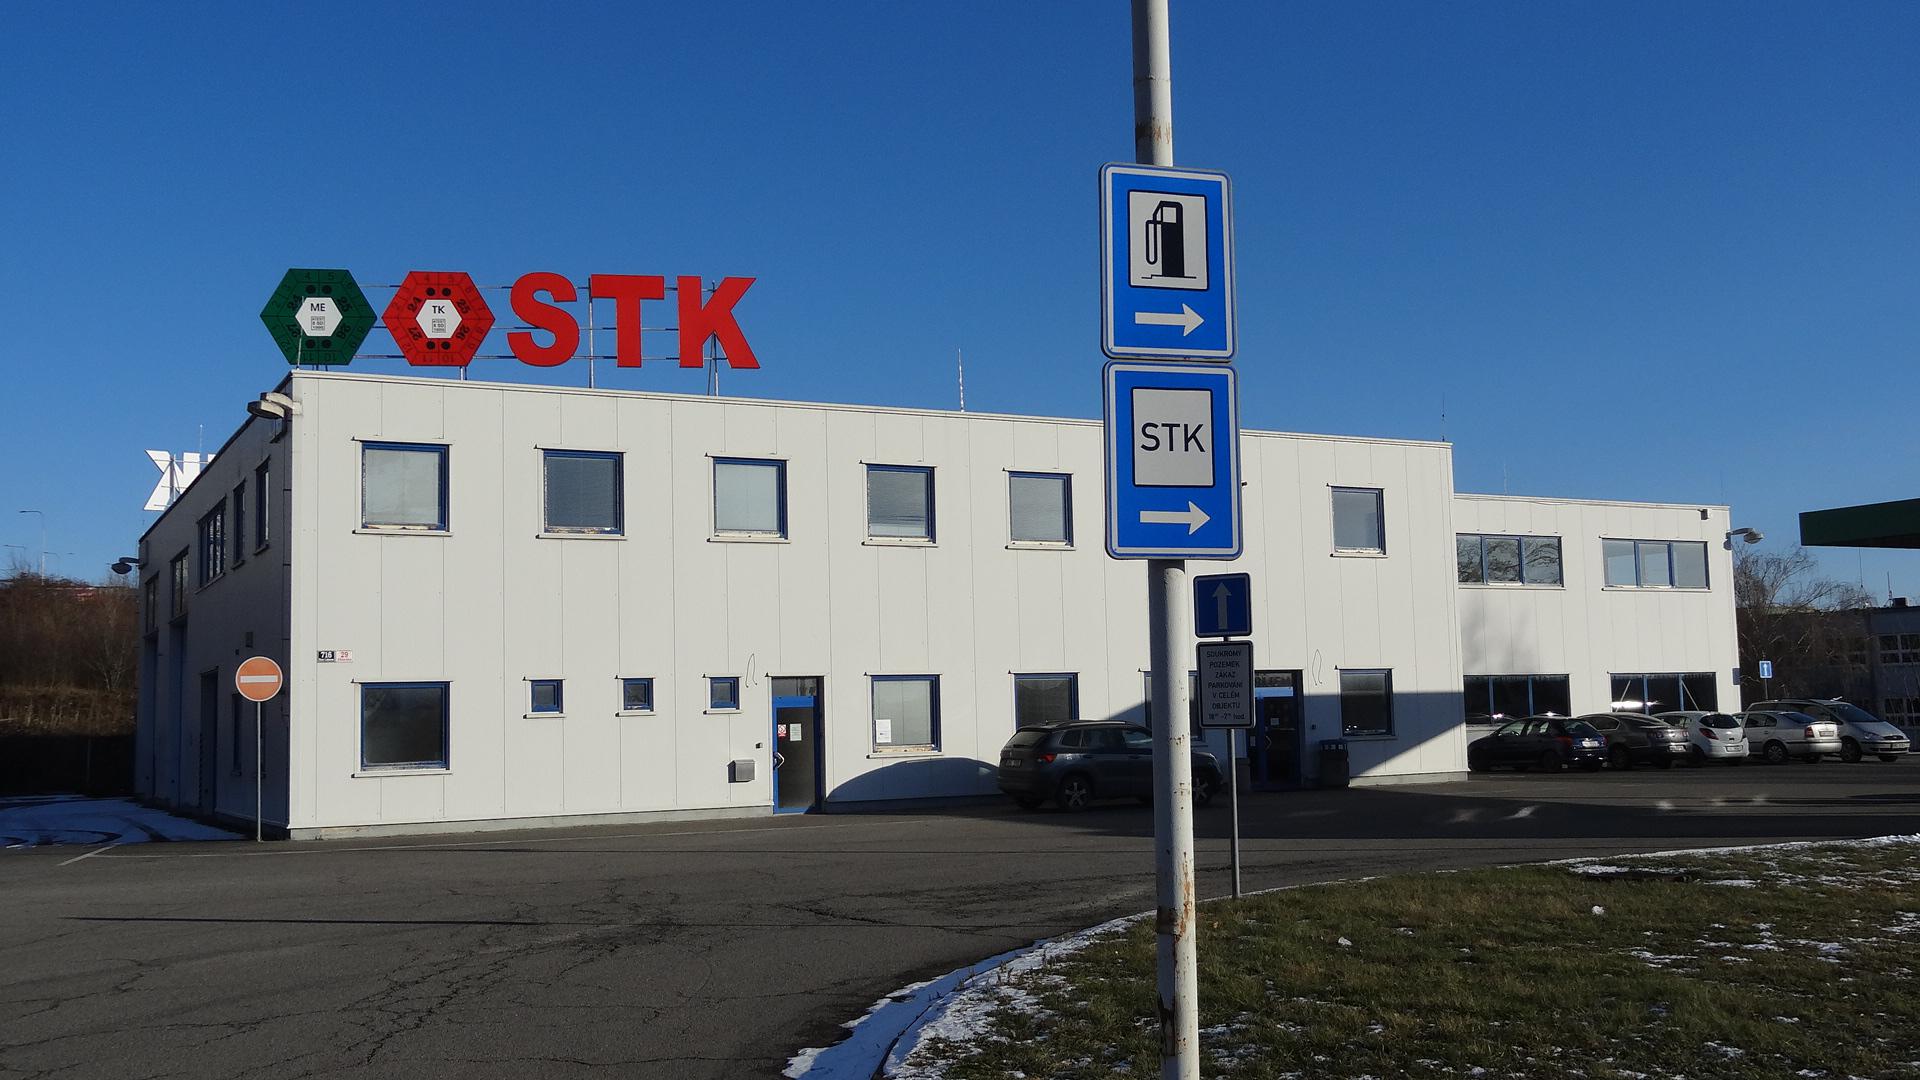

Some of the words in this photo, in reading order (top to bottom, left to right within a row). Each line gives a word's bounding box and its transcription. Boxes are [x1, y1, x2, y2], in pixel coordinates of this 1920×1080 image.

[310, 302, 326, 312] ME
[432, 305, 446, 314] TK
[507, 271, 761, 369] STK
[1140, 422, 1206, 453] STK
[1209, 660, 1240, 669] POZEMEK
[1211, 701, 1241, 710] OBJEKTU
